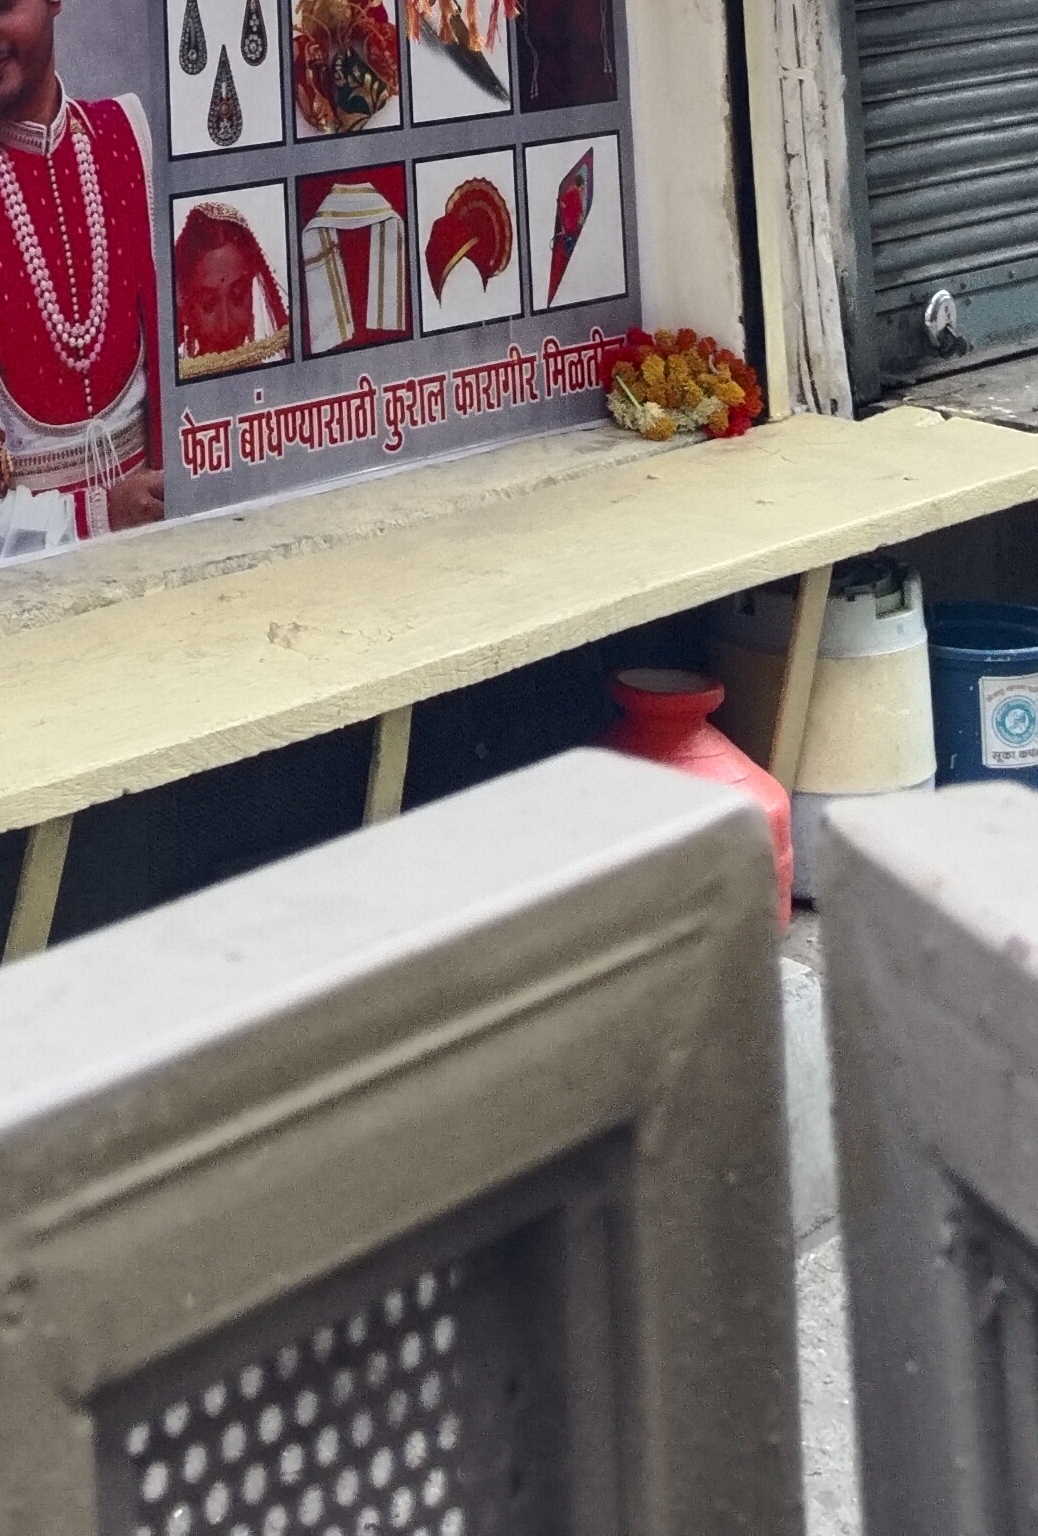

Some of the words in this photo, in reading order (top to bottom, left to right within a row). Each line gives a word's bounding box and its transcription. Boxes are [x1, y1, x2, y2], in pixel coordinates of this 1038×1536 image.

[179, 408, 232, 479] फेटा
[237, 375, 378, 464] बांधण्यासाठी
[383, 372, 447, 455] कुशल
[452, 342, 539, 416] कारागीर
[542, 326, 627, 398] मिळती
